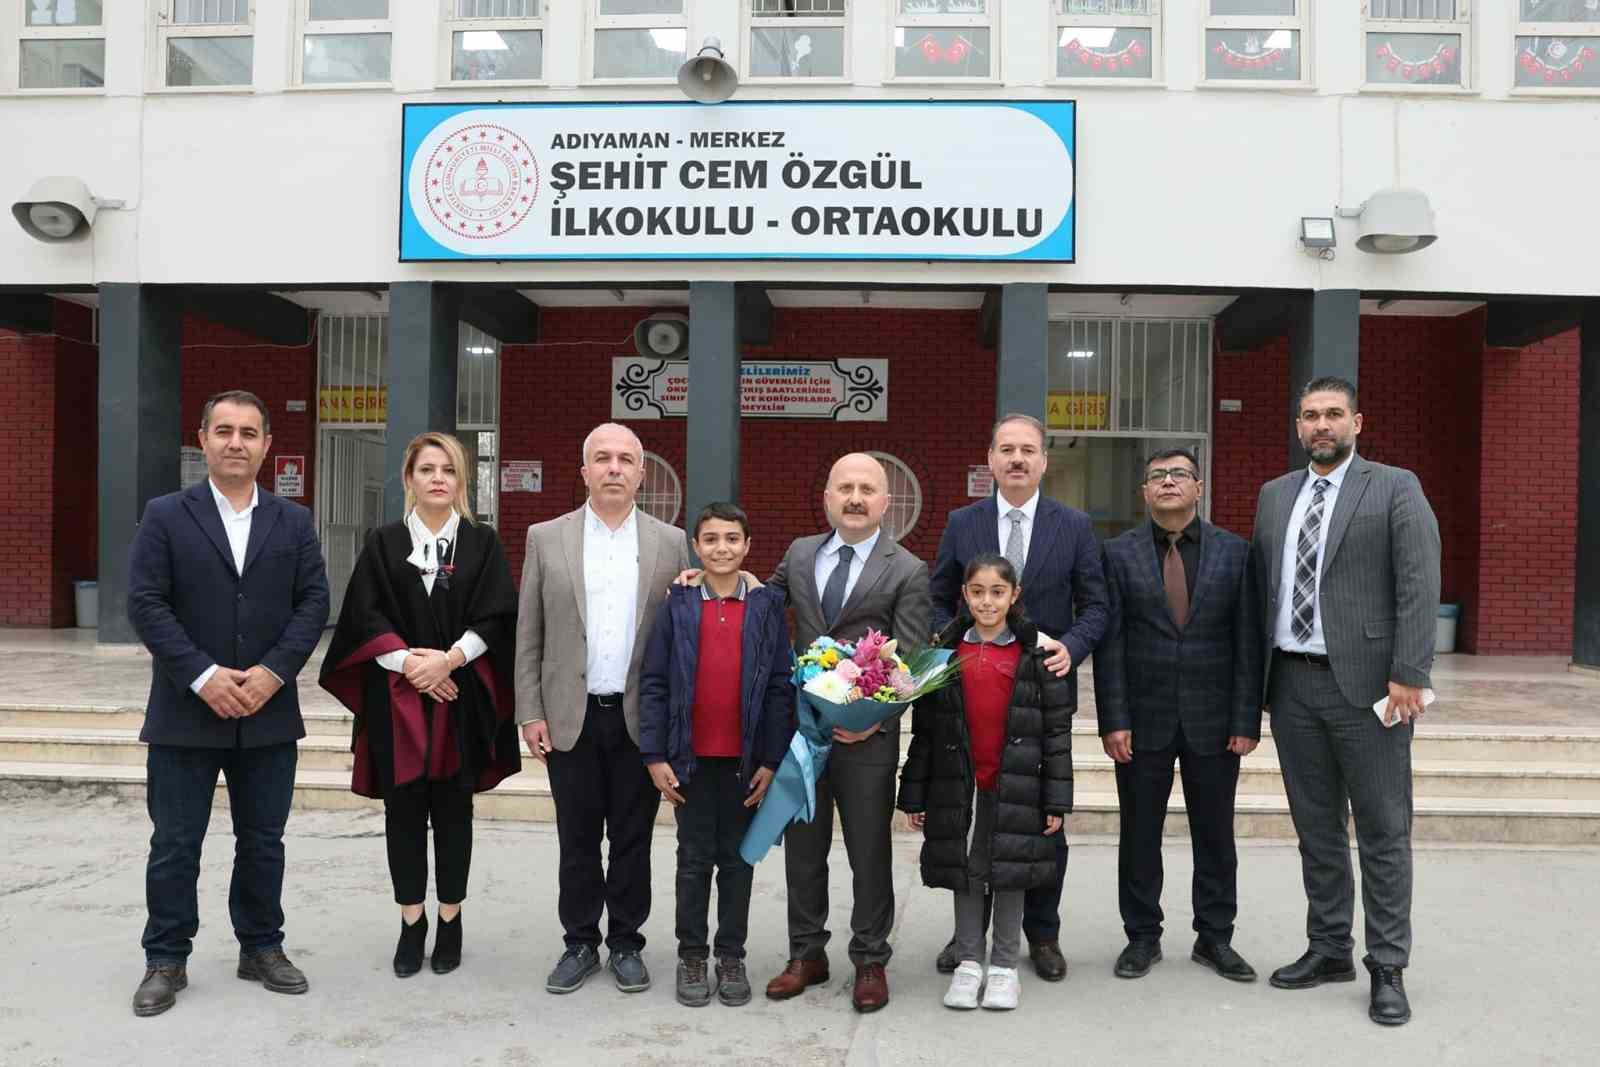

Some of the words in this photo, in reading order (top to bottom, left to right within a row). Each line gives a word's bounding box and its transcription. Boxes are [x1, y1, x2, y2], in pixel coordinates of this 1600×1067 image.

[551, 133, 669, 149] ADIYAMAN
[691, 132, 785, 147] MERKEZ
[550, 152, 668, 199] ŞEHİT
[680, 161, 767, 189] CEM
[782, 152, 922, 189] ÖZGÜL
[551, 200, 753, 236] İLKOKULU
[792, 206, 1043, 237] ORTAOKULU
[738, 366, 811, 376] ELİLERİMİZ
[766, 386, 832, 394] SAATLERİNDE
